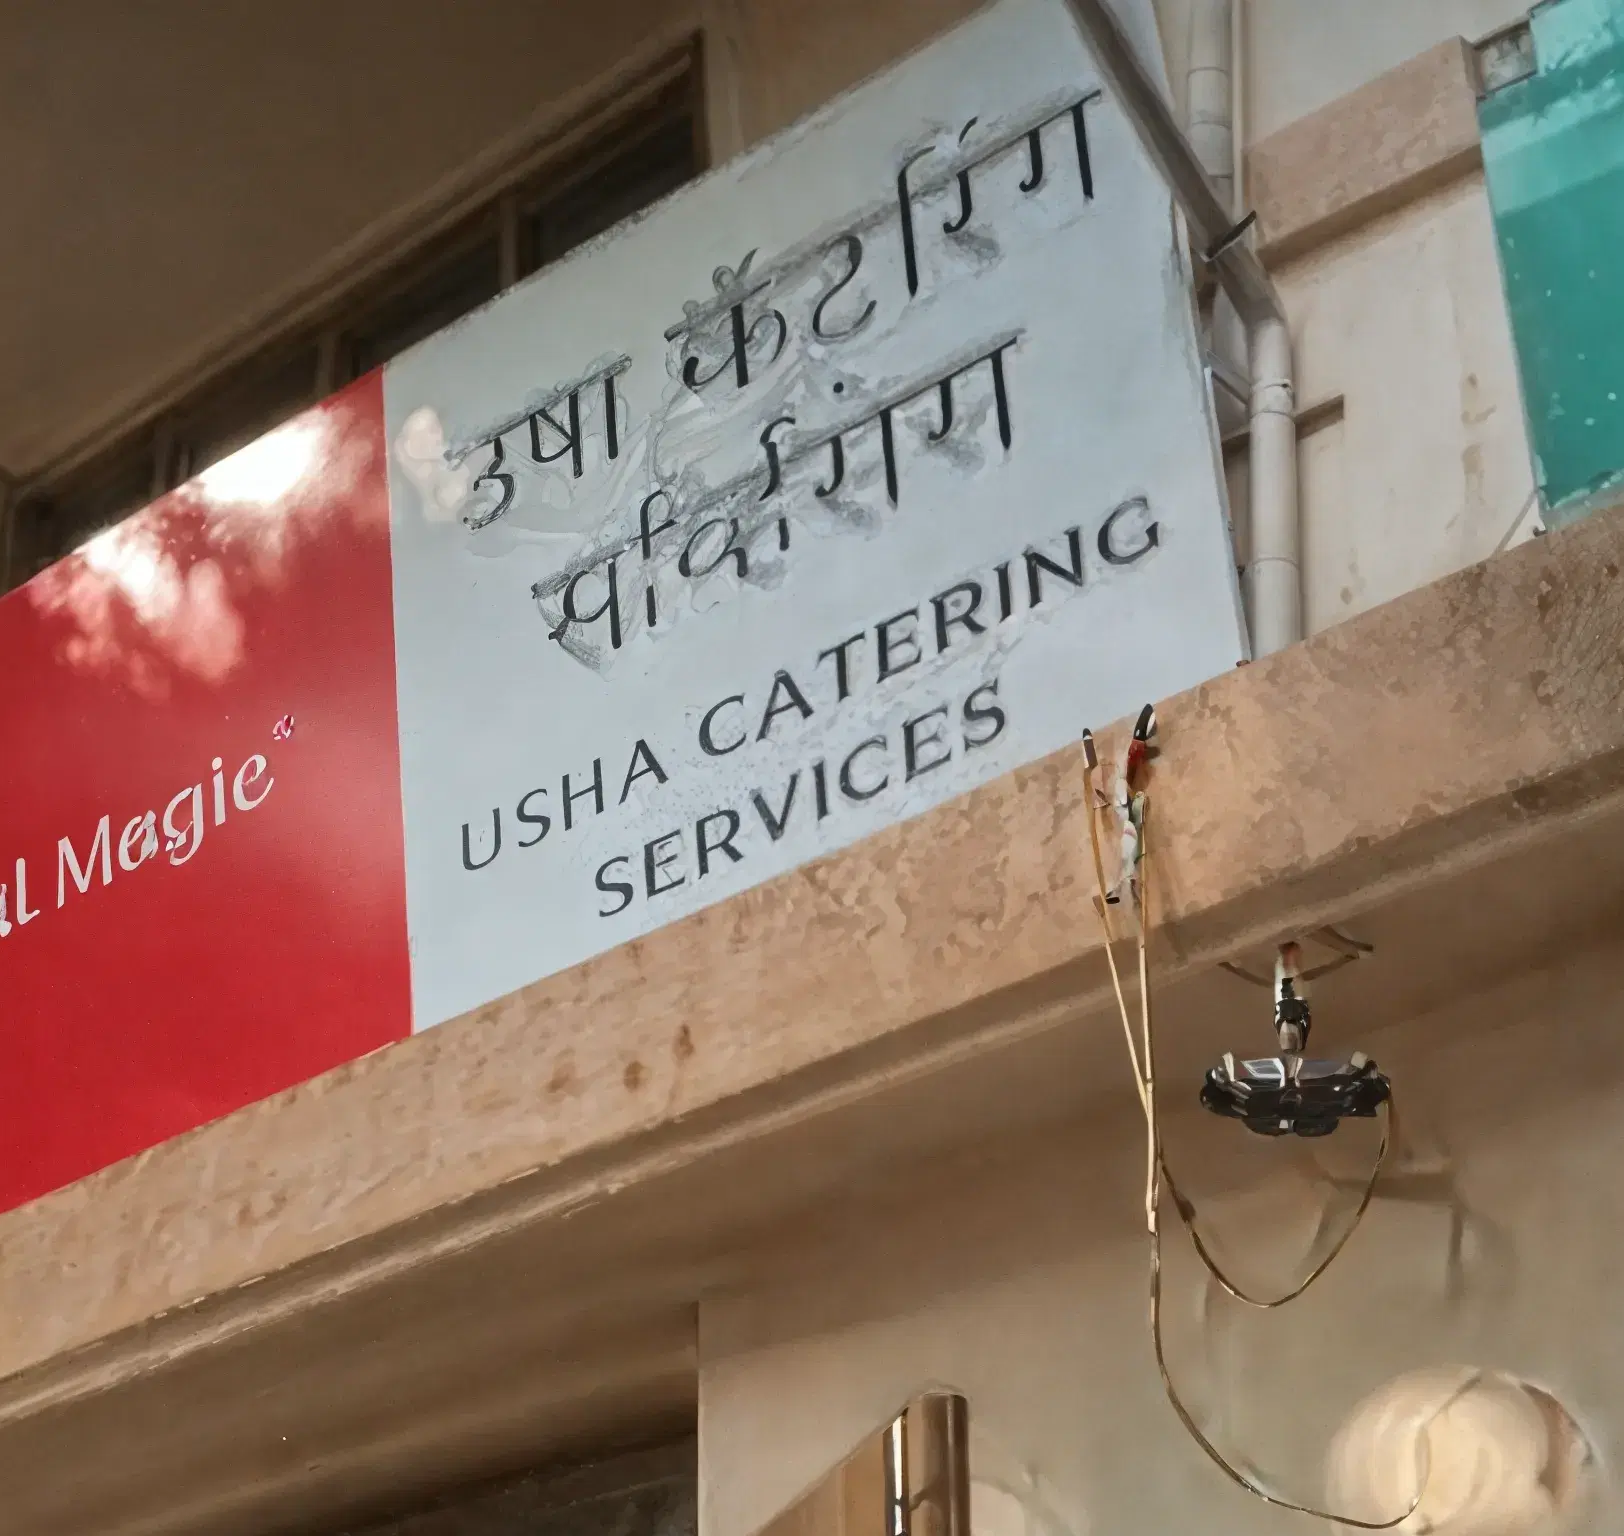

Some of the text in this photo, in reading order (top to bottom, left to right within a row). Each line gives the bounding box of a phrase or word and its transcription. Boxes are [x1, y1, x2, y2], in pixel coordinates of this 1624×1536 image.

[461, 496, 1161, 872] USHA CATERING
[593, 679, 1007, 918] SERVICES
